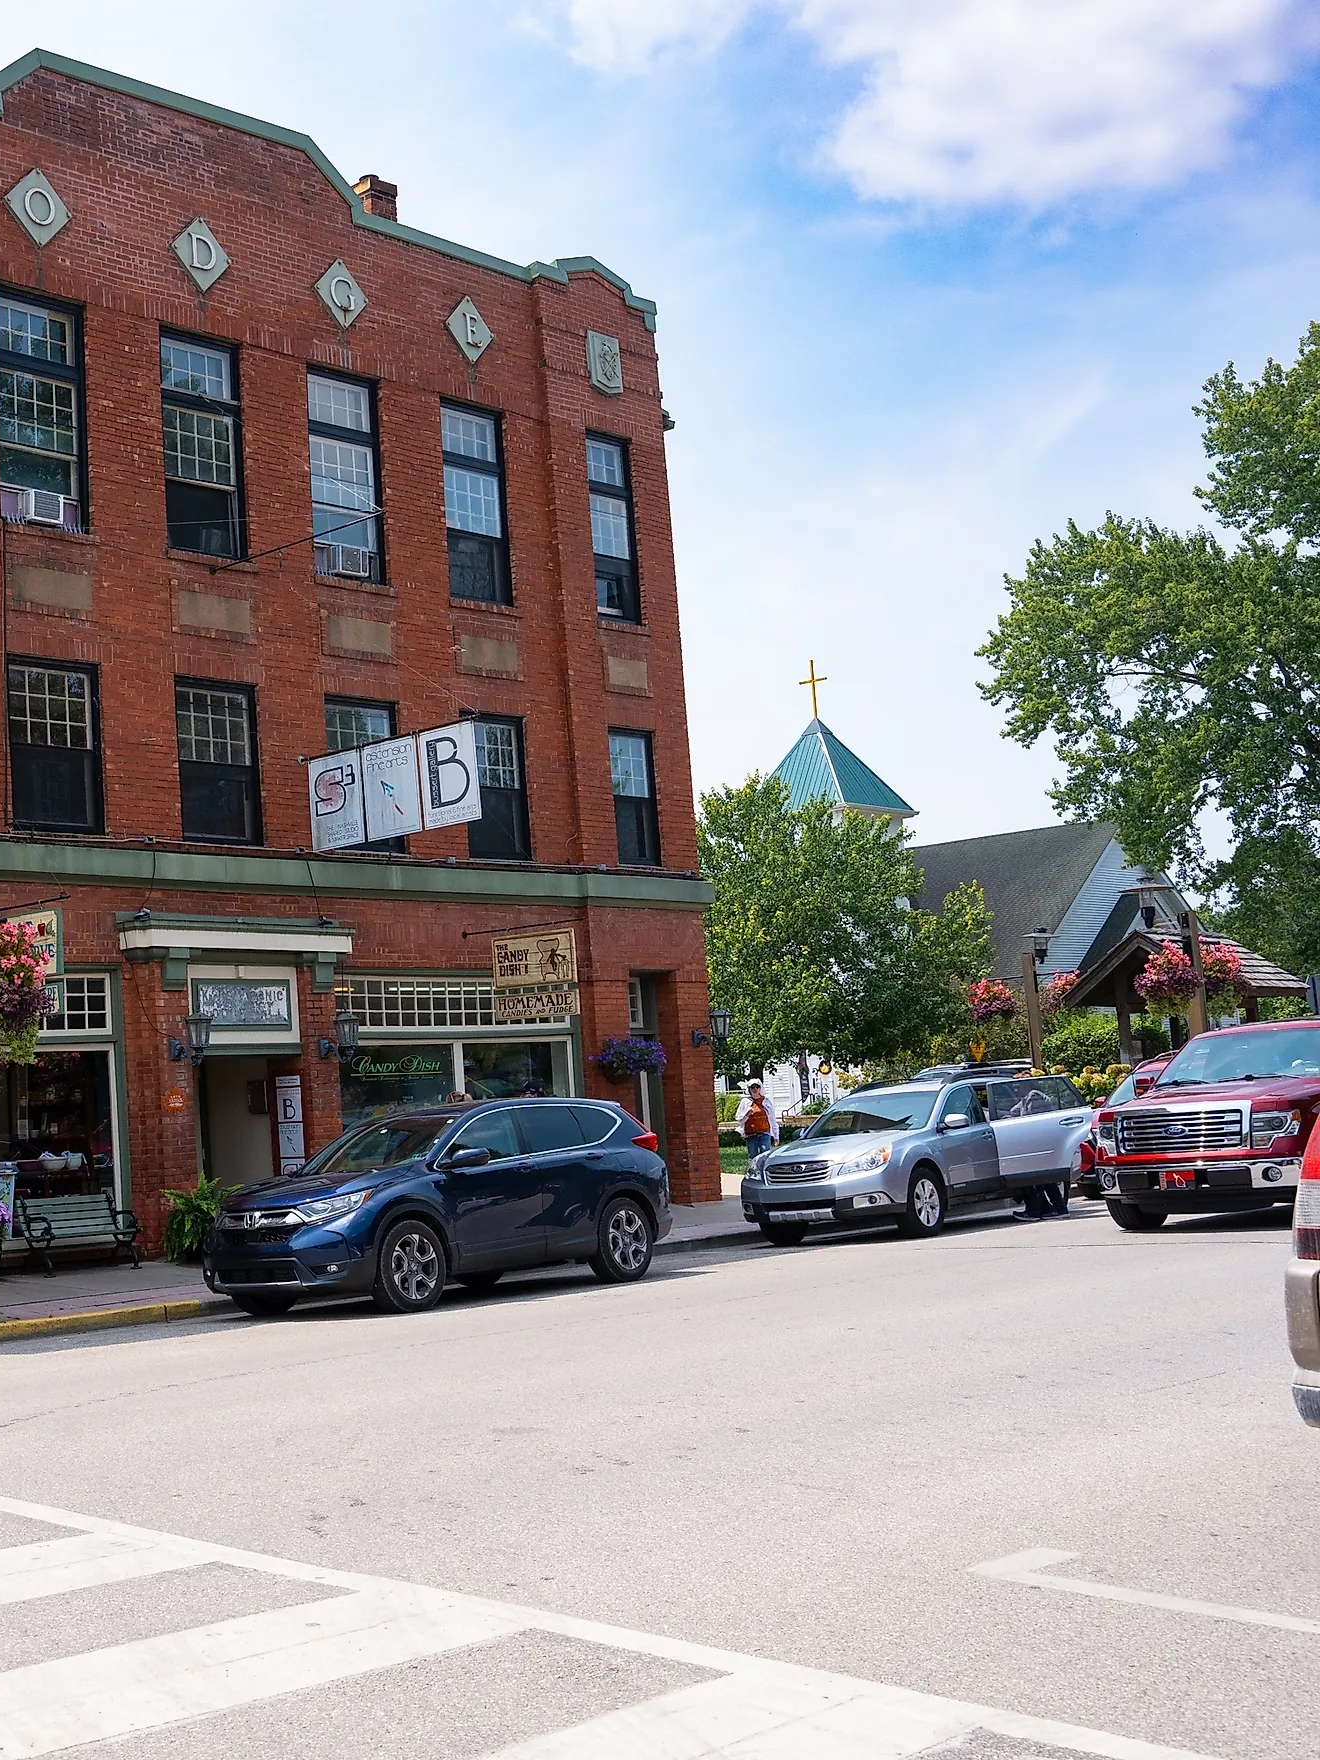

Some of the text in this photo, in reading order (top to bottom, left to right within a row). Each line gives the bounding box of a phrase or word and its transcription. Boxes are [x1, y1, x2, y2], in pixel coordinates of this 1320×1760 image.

[425, 736, 471, 810] B
[495, 944, 509, 952] THE
[497, 948, 529, 964] CANDY
[498, 993, 573, 1011] HOMEMADE
[501, 1008, 533, 1018] CANDIES
[548, 1005, 574, 1014] FUDGE
[351, 1054, 440, 1074] CANDY DISH
[282, 1099, 296, 1120] B
